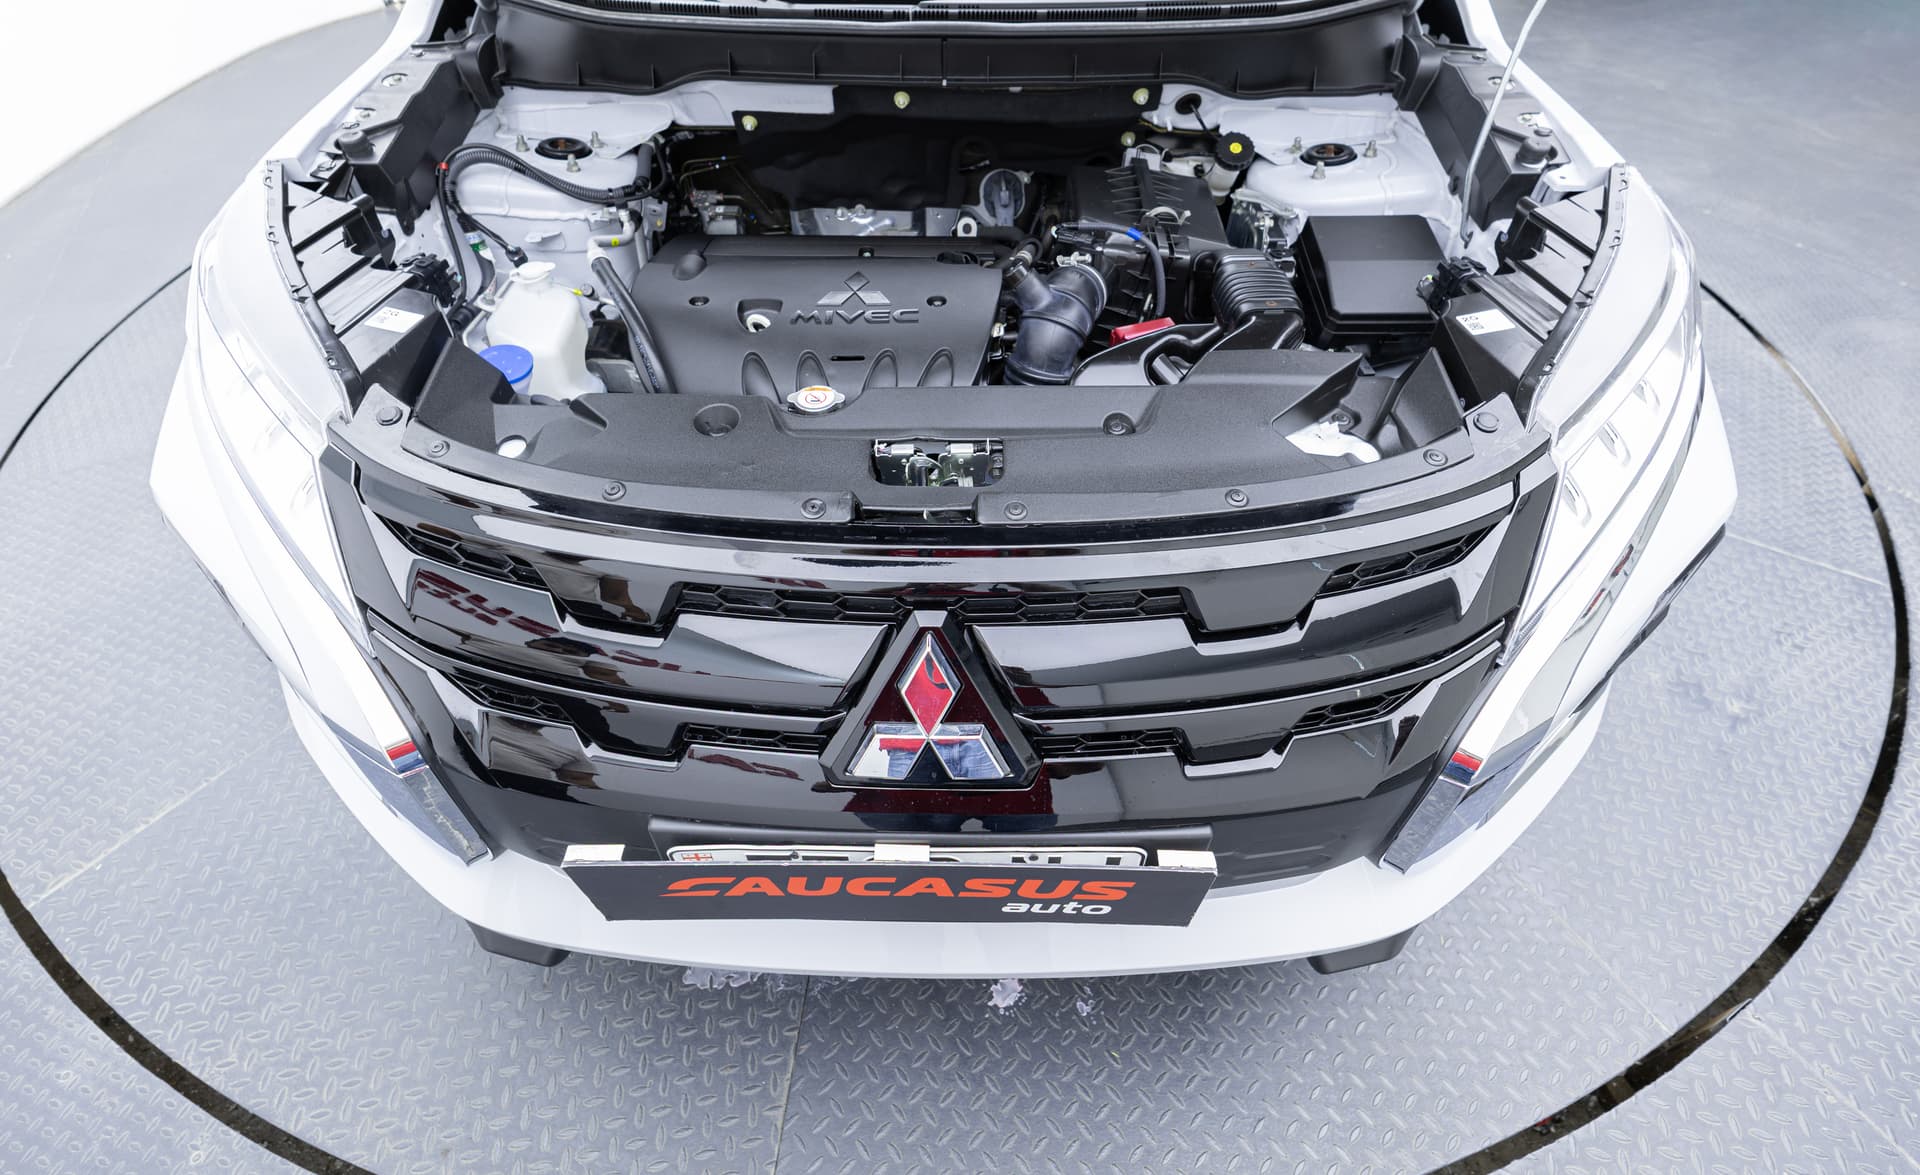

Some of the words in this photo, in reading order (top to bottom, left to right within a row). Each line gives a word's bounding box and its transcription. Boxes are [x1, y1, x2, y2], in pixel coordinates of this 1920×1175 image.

[790, 308, 920, 325] MIVEC
[659, 876, 1136, 901] CAUCASUS
[1001, 901, 1112, 915] auto
